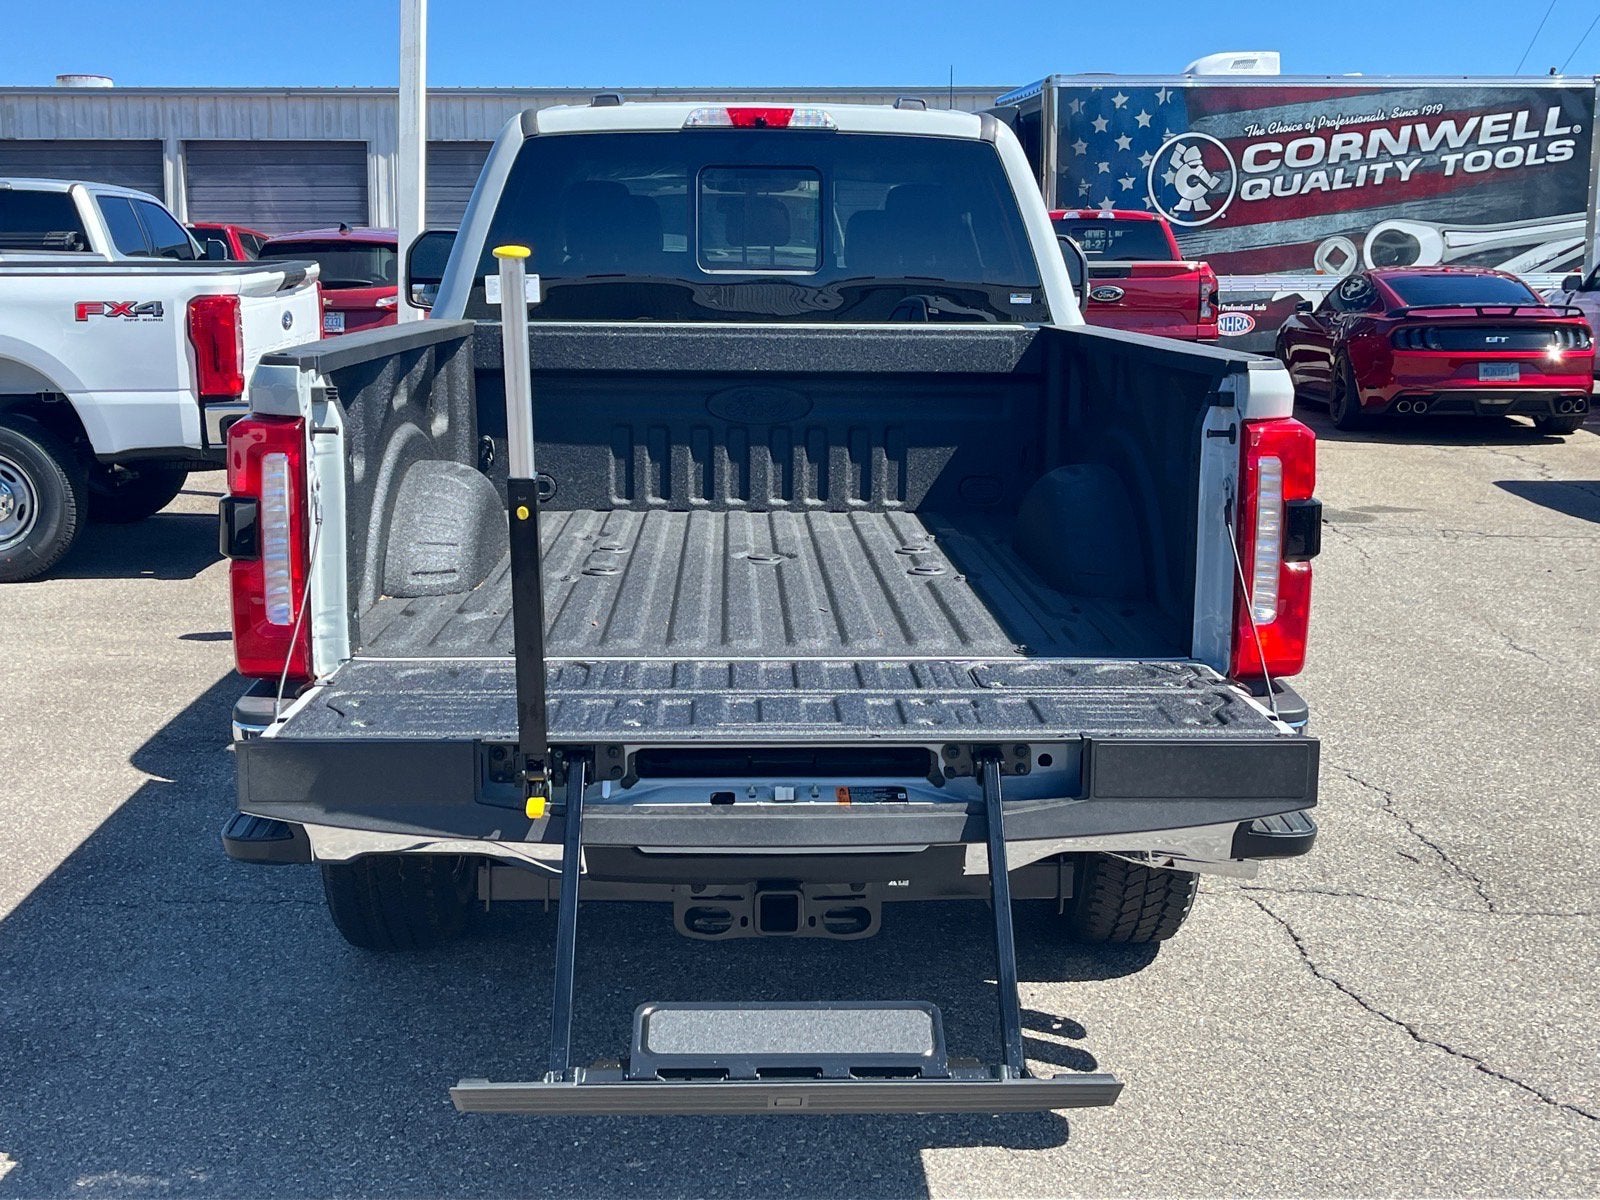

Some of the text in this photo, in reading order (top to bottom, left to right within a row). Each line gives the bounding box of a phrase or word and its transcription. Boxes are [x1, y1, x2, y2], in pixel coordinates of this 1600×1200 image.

[1244, 125, 1266, 138] The
[1267, 121, 1303, 134] Choice
[1304, 118, 1317, 134] of
[1390, 106, 1419, 120] Since
[1421, 103, 1444, 117] 1919
[1240, 139, 1576, 201] QUALITY TOOLS
[74, 301, 164, 322] FX4
[1221, 303, 1254, 312] Professional
[1254, 303, 1267, 311] Tools
[1218, 317, 1249, 331] NHRA
